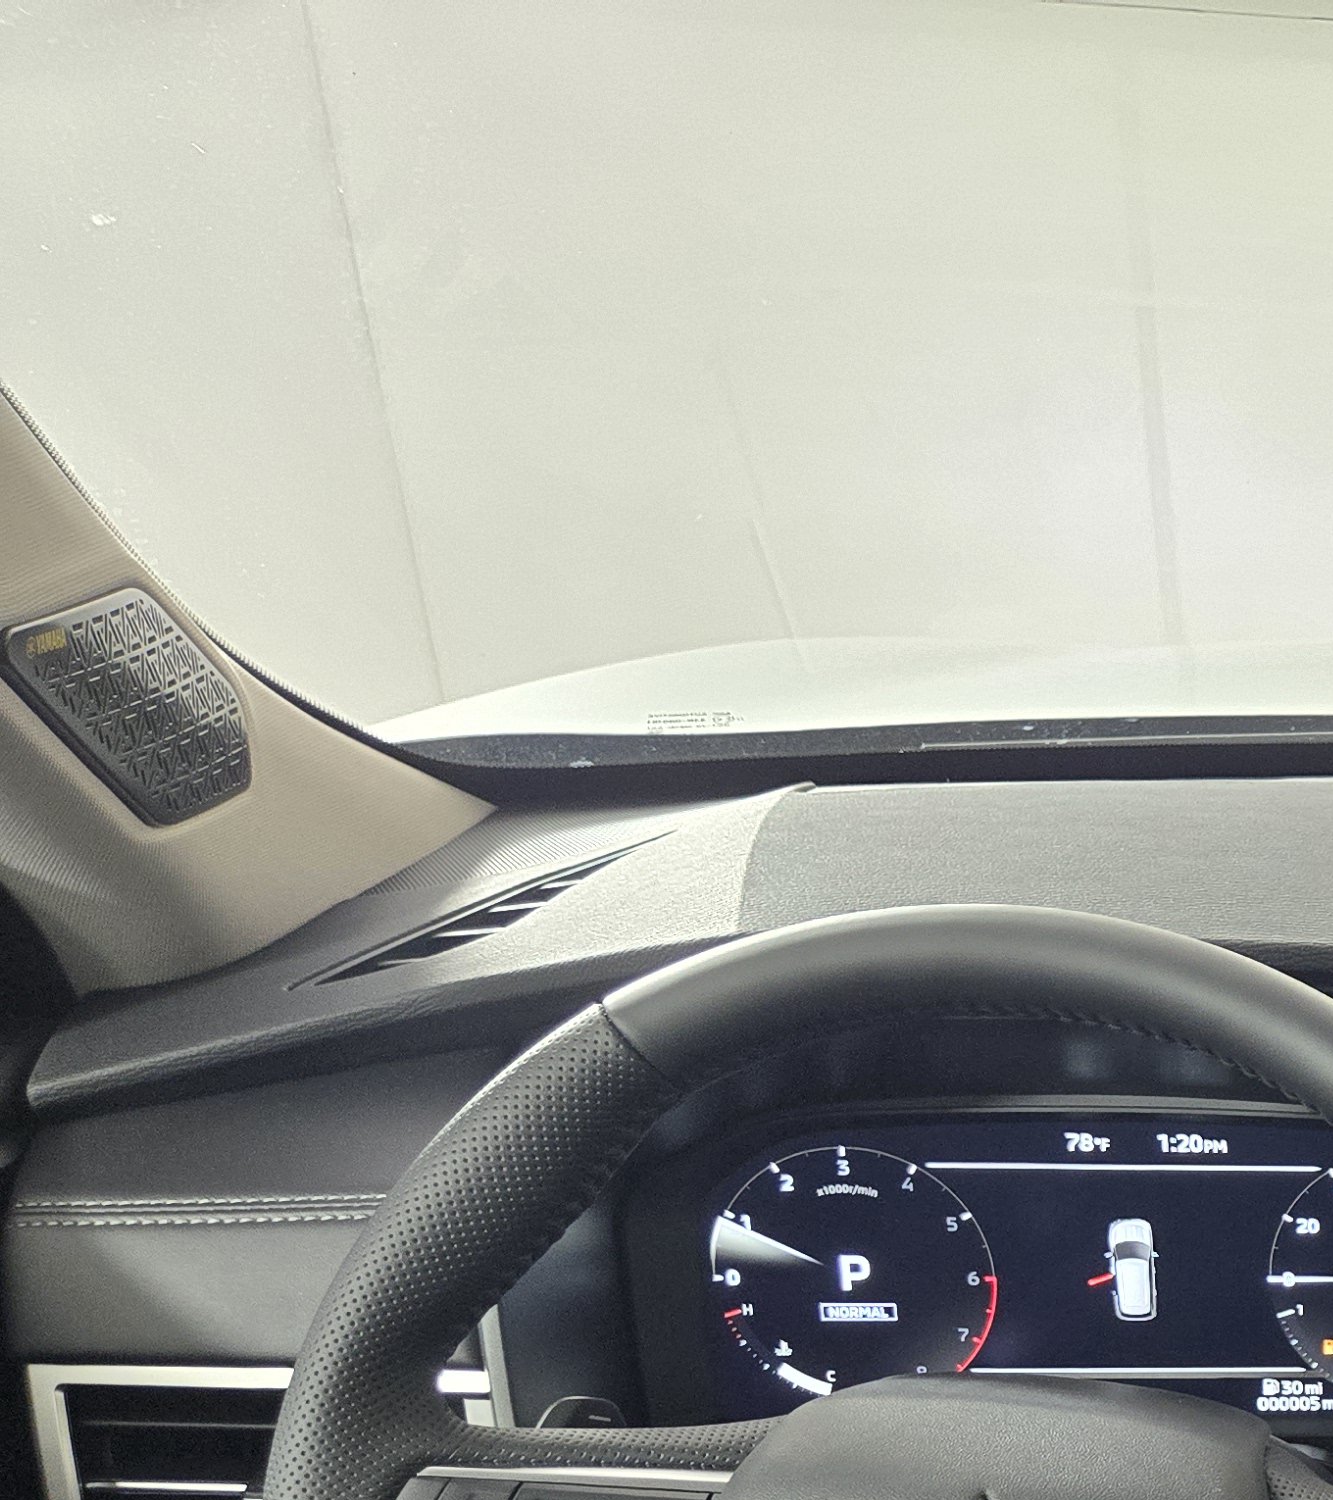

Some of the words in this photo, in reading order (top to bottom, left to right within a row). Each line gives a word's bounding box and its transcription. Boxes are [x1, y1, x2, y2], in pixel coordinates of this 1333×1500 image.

[836, 1160, 851, 1176] 3
[779, 1174, 795, 1192] 2
[902, 1178, 915, 1192] 4
[946, 1217, 958, 1232] 5
[1296, 1217, 1321, 1235] 20
[724, 1269, 742, 1286] 0
[838, 1254, 871, 1291] P
[967, 1272, 980, 1286] 6
[742, 1303, 754, 1316] H
[828, 1305, 890, 1320] NORMAL
[958, 1328, 969, 1342] 7
[826, 1369, 836, 1383] C
[1281, 1380, 1303, 1395] 30
[1305, 1382, 1323, 1395] mi
[1256, 1396, 1321, 1412] 000005
